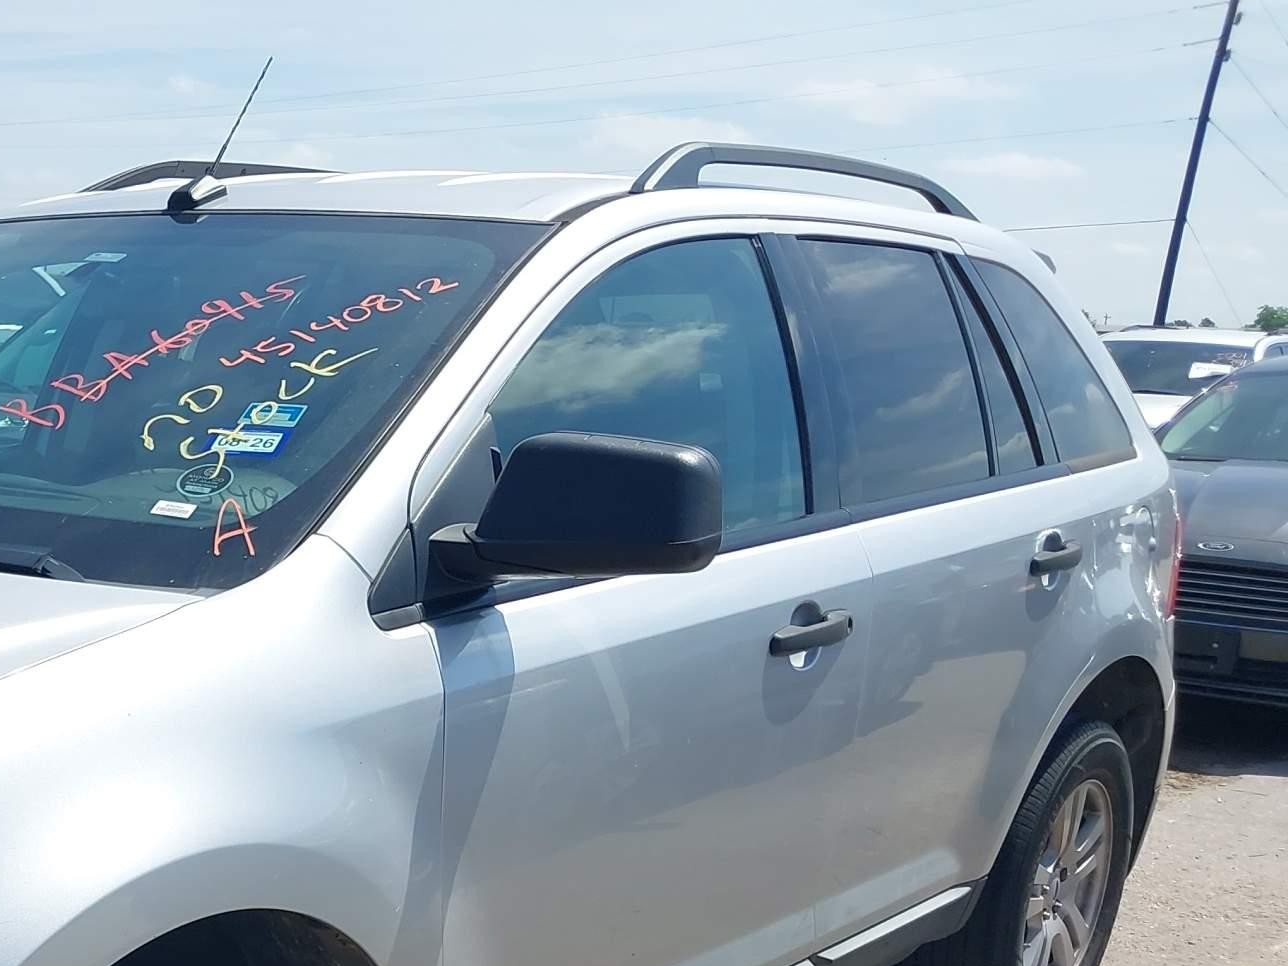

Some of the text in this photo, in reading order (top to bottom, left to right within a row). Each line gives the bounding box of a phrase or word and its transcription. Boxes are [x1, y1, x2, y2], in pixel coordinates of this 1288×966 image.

[219, 277, 459, 367] 45140812
[249, 437, 276, 449] 26
[213, 498, 258, 556] A
